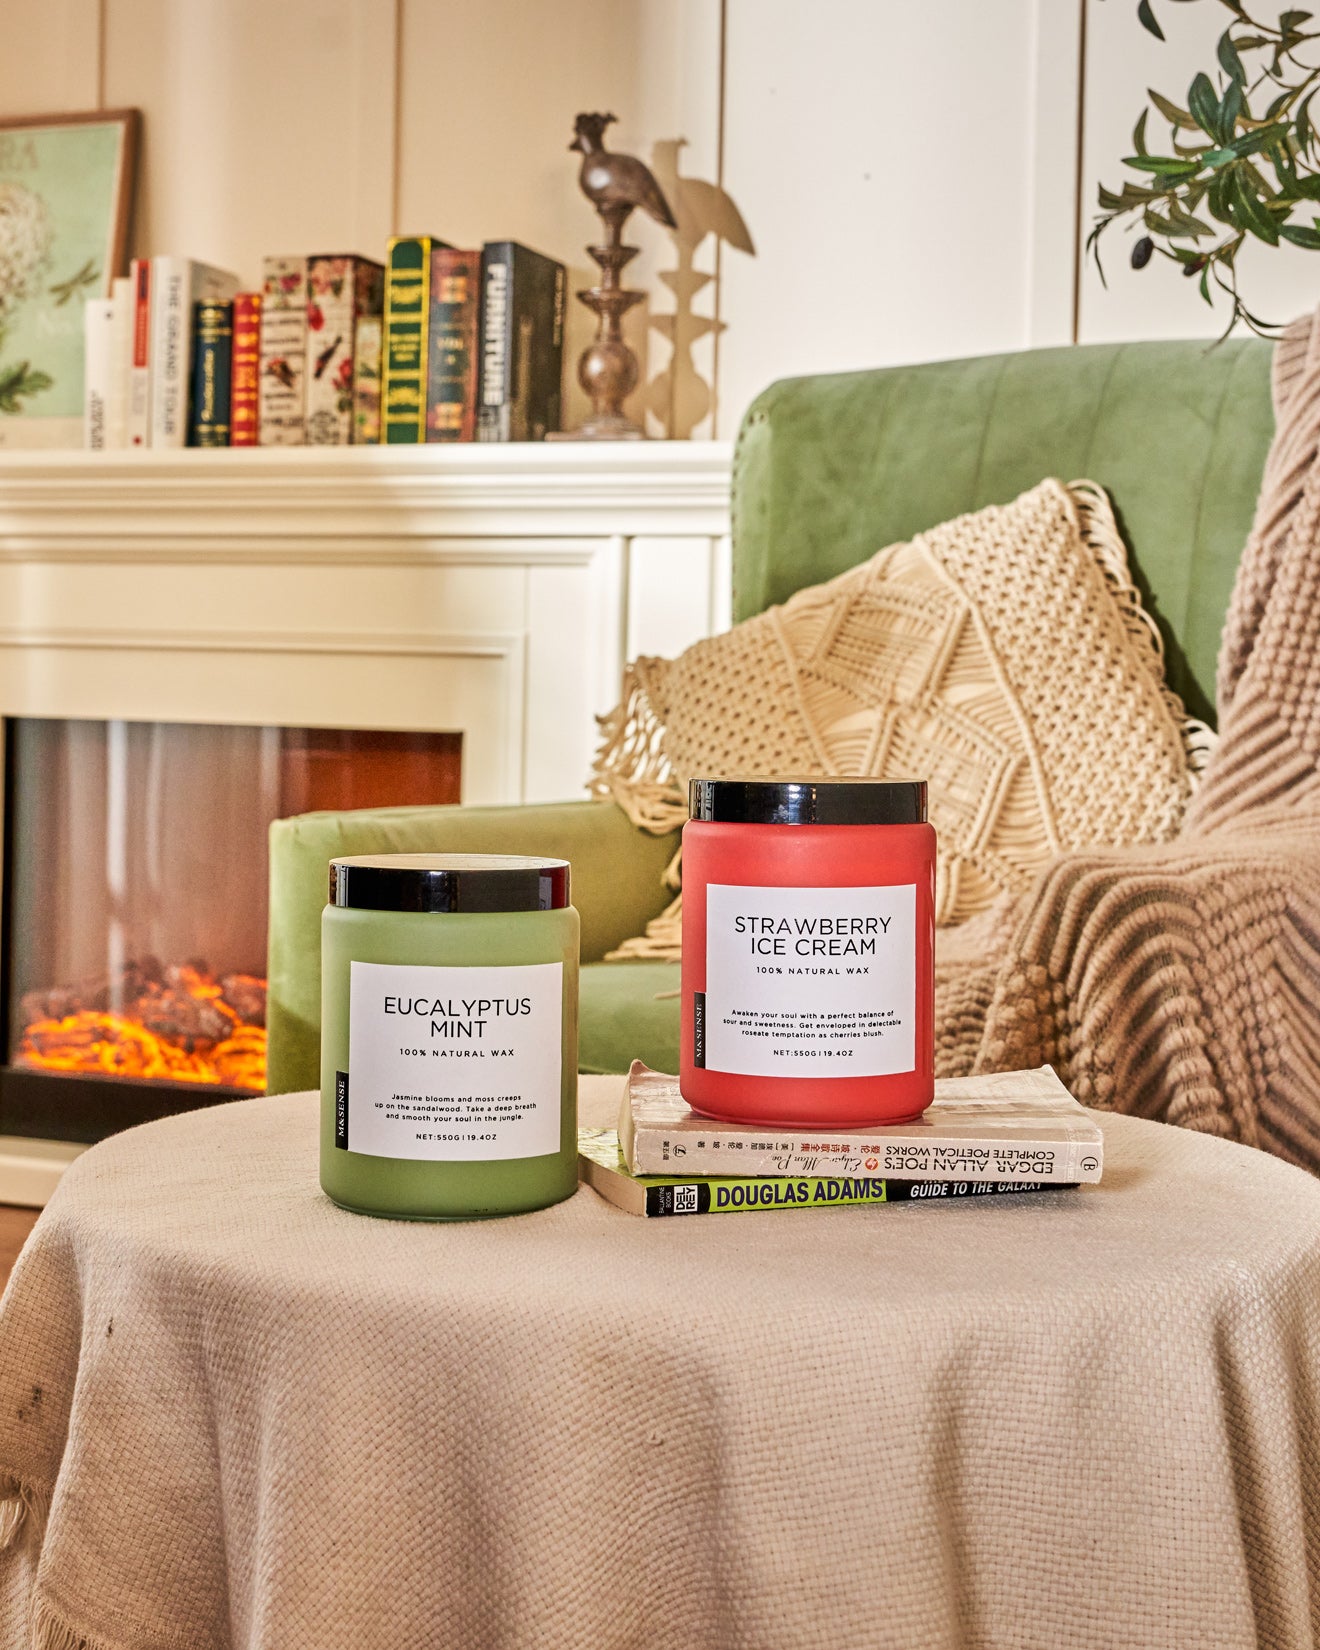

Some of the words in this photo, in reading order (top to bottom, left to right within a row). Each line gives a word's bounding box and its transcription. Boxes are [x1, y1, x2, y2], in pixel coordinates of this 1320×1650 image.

[483, 263, 507, 406] FURNITURE
[734, 915, 892, 936] STRAWBERRY
[751, 937, 787, 956] ICE
[794, 937, 876, 957] CREAM
[756, 966, 783, 975] 100%
[788, 967, 841, 976] NATURAL
[845, 966, 870, 975] WAX
[384, 996, 532, 1018] EUCALYPTUS
[731, 1009, 759, 1018] Awaken
[827, 1012, 856, 1020] perfect
[858, 1011, 885, 1019] balance
[430, 1019, 488, 1039] MINT
[739, 1019, 752, 1027] and
[754, 1021, 796, 1029] sweetness.
[868, 1019, 902, 1028] delectable
[742, 1029, 769, 1037] roseate
[772, 1030, 816, 1039] temptation
[863, 1030, 884, 1038] blush.
[399, 1047, 427, 1057] 100%
[432, 1049, 486, 1058] NATURAL
[490, 1048, 515, 1057] WAX
[391, 1093, 423, 1102] Jasmine
[425, 1095, 455, 1103] blooms
[497, 1095, 522, 1103] creeps
[413, 1105, 463, 1113] sandalwood.
[514, 1103, 537, 1111] breath
[386, 1112, 400, 1120] and
[402, 1114, 431, 1122] smooth
[499, 1113, 524, 1122] jungle.
[886, 1145, 931, 1157] WORKS
[932, 1147, 990, 1158] POETICAL
[993, 1149, 1055, 1160] COMPLETE
[884, 1157, 928, 1171] POE'S
[933, 1159, 989, 1172] ALLAN
[997, 1160, 1054, 1174] EDGAR
[717, 1182, 809, 1207] DOUGLAS
[814, 1178, 883, 1202] ADAMS
[910, 1183, 949, 1198] GUIDE
[952, 1182, 968, 1195] TO
[971, 1181, 993, 1194] THE
[676, 1188, 686, 1211] DEL
[686, 1187, 696, 1210] REY
